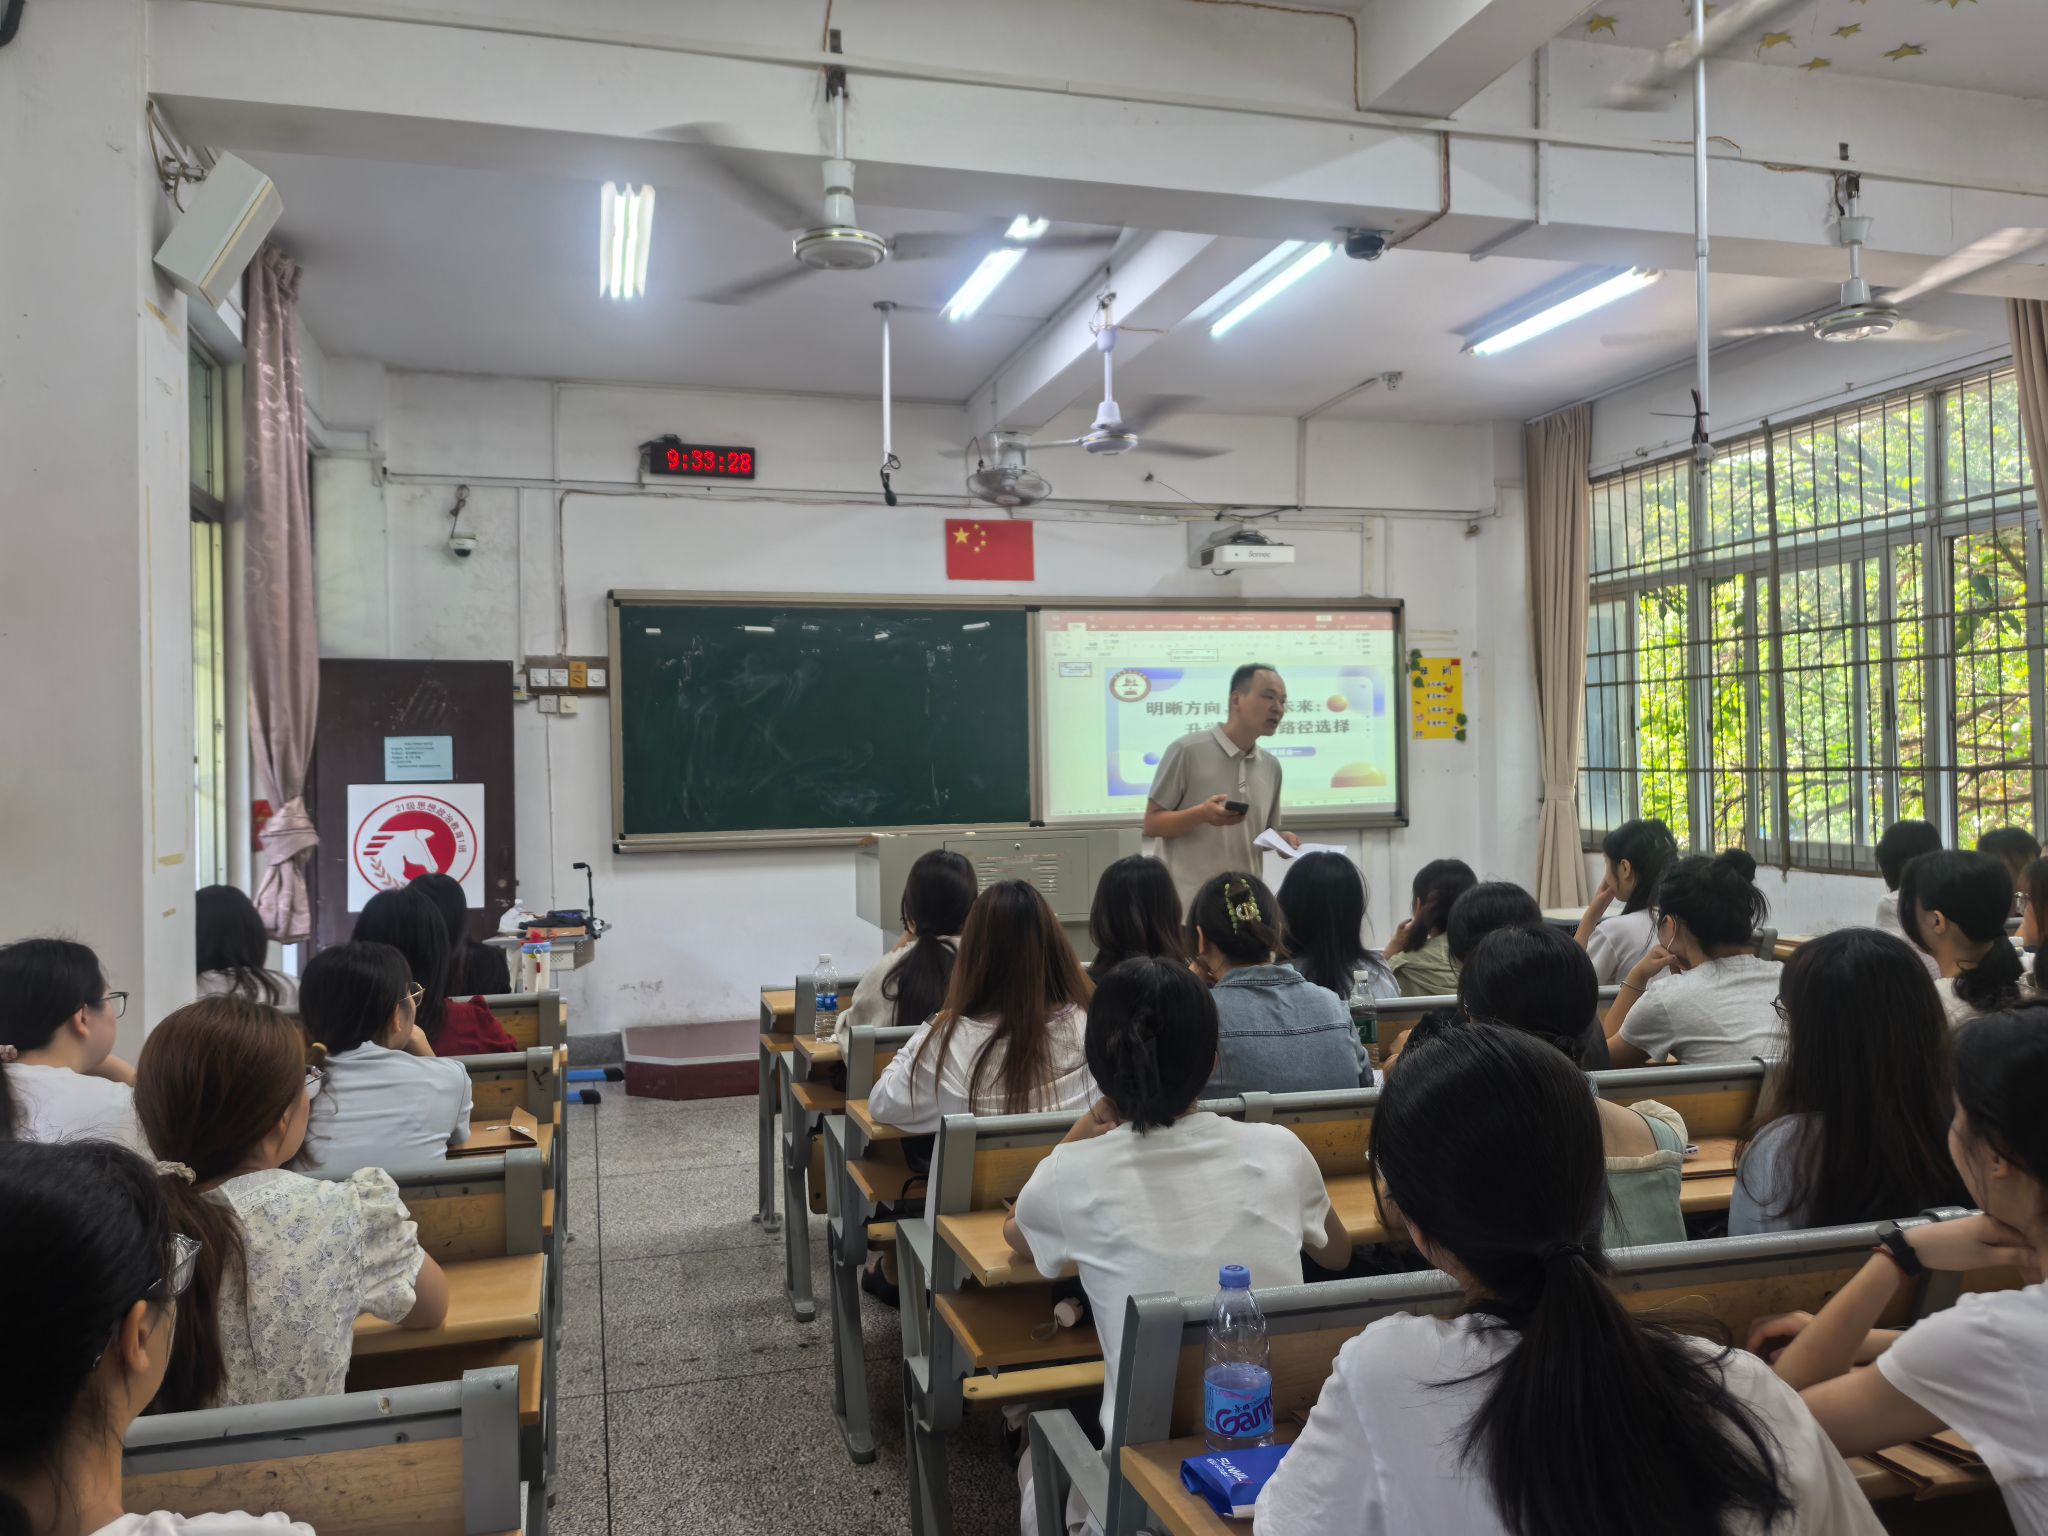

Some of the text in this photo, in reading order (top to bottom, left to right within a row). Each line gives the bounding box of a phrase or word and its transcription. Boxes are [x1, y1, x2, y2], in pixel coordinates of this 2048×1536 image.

[667, 448, 751, 474] 9:33:28
[1146, 701, 1221, 716] 明晰方向
